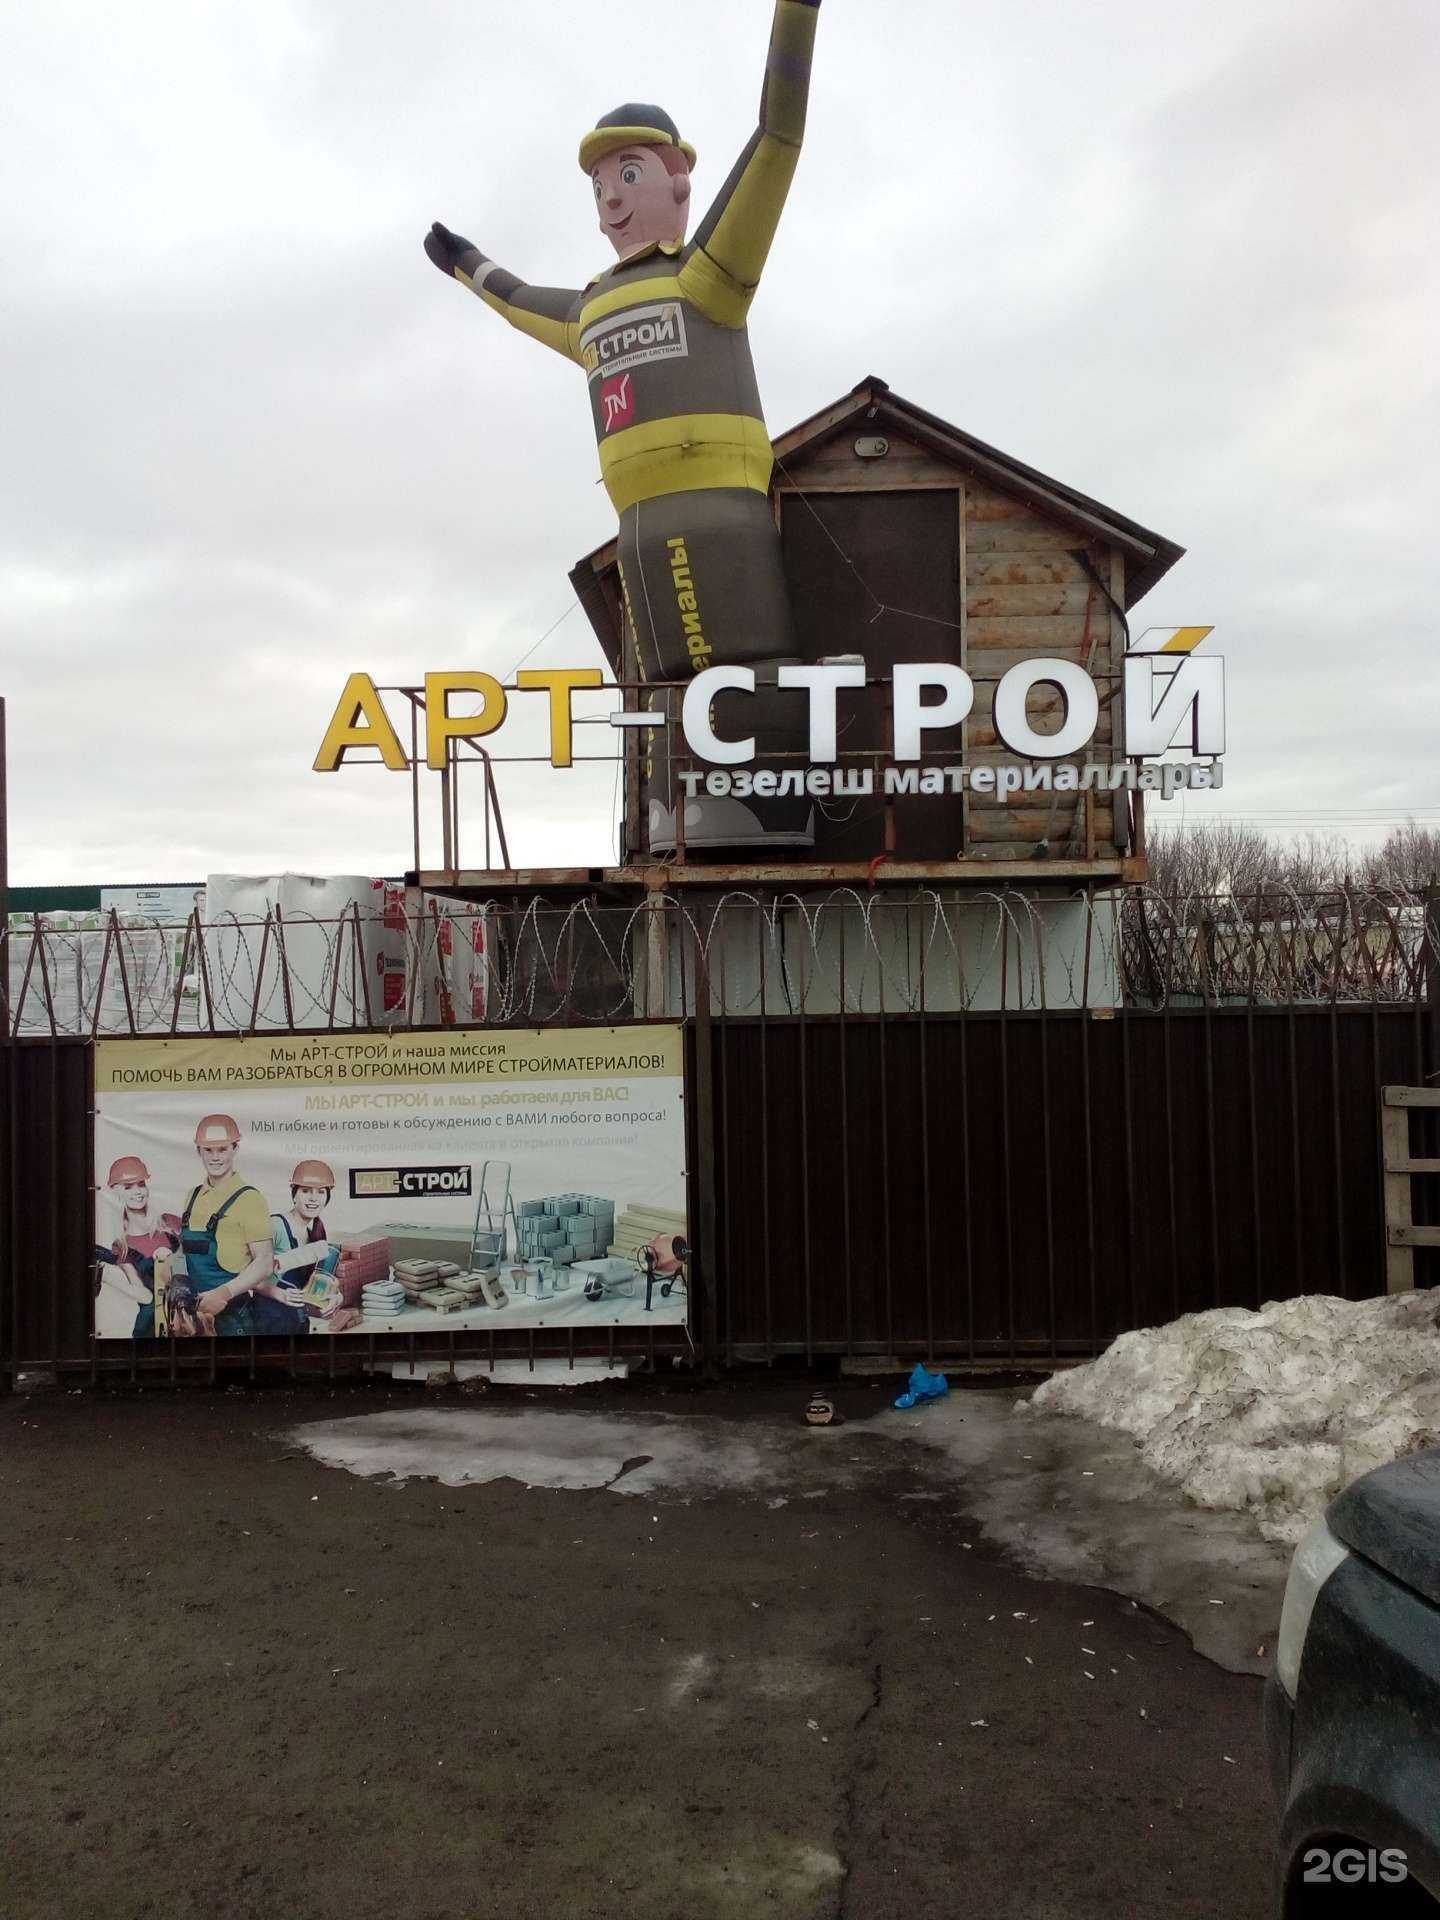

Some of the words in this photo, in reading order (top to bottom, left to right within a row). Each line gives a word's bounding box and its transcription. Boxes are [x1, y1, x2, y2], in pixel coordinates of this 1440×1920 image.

[666, 537, 713, 672] ериалы
[679, 766, 873, 798] төзелеш
[884, 760, 1224, 803] материаллары
[270, 1048, 296, 1062] Мы
[301, 1043, 388, 1061] АРТ-СТРОЙ
[392, 1049, 402, 1058] и
[406, 1046, 446, 1058] наша
[450, 1044, 506, 1056] миссия
[112, 1068, 183, 1083] ПОМОЧЬ
[187, 1067, 222, 1082] ВАМ
[226, 1064, 333, 1081] РАЗОБРАТЬСЯ
[338, 1064, 347, 1077] В
[351, 1060, 446, 1078] ОГРОМНОМ
[450, 1060, 494, 1075] МИРЕ
[499, 1055, 665, 1073] СТРОЙМАТЕРИАЛОВ!
[339, 1089, 428, 1109] АРТ-СТРОЙ
[434, 1096, 444, 1106] и
[449, 1094, 476, 1106] мы
[481, 1089, 559, 1109] работаем
[561, 1092, 592, 1105] для
[279, 1118, 327, 1132] гибкие
[331, 1121, 338, 1130] и
[342, 1119, 390, 1131] готовы
[393, 1120, 401, 1129] к
[404, 1116, 492, 1131] обсуждению
[495, 1117, 502, 1126] с
[506, 1112, 547, 1126] ВАМИ
[550, 1111, 601, 1125] любого
[605, 1109, 666, 1124] вопроса!
